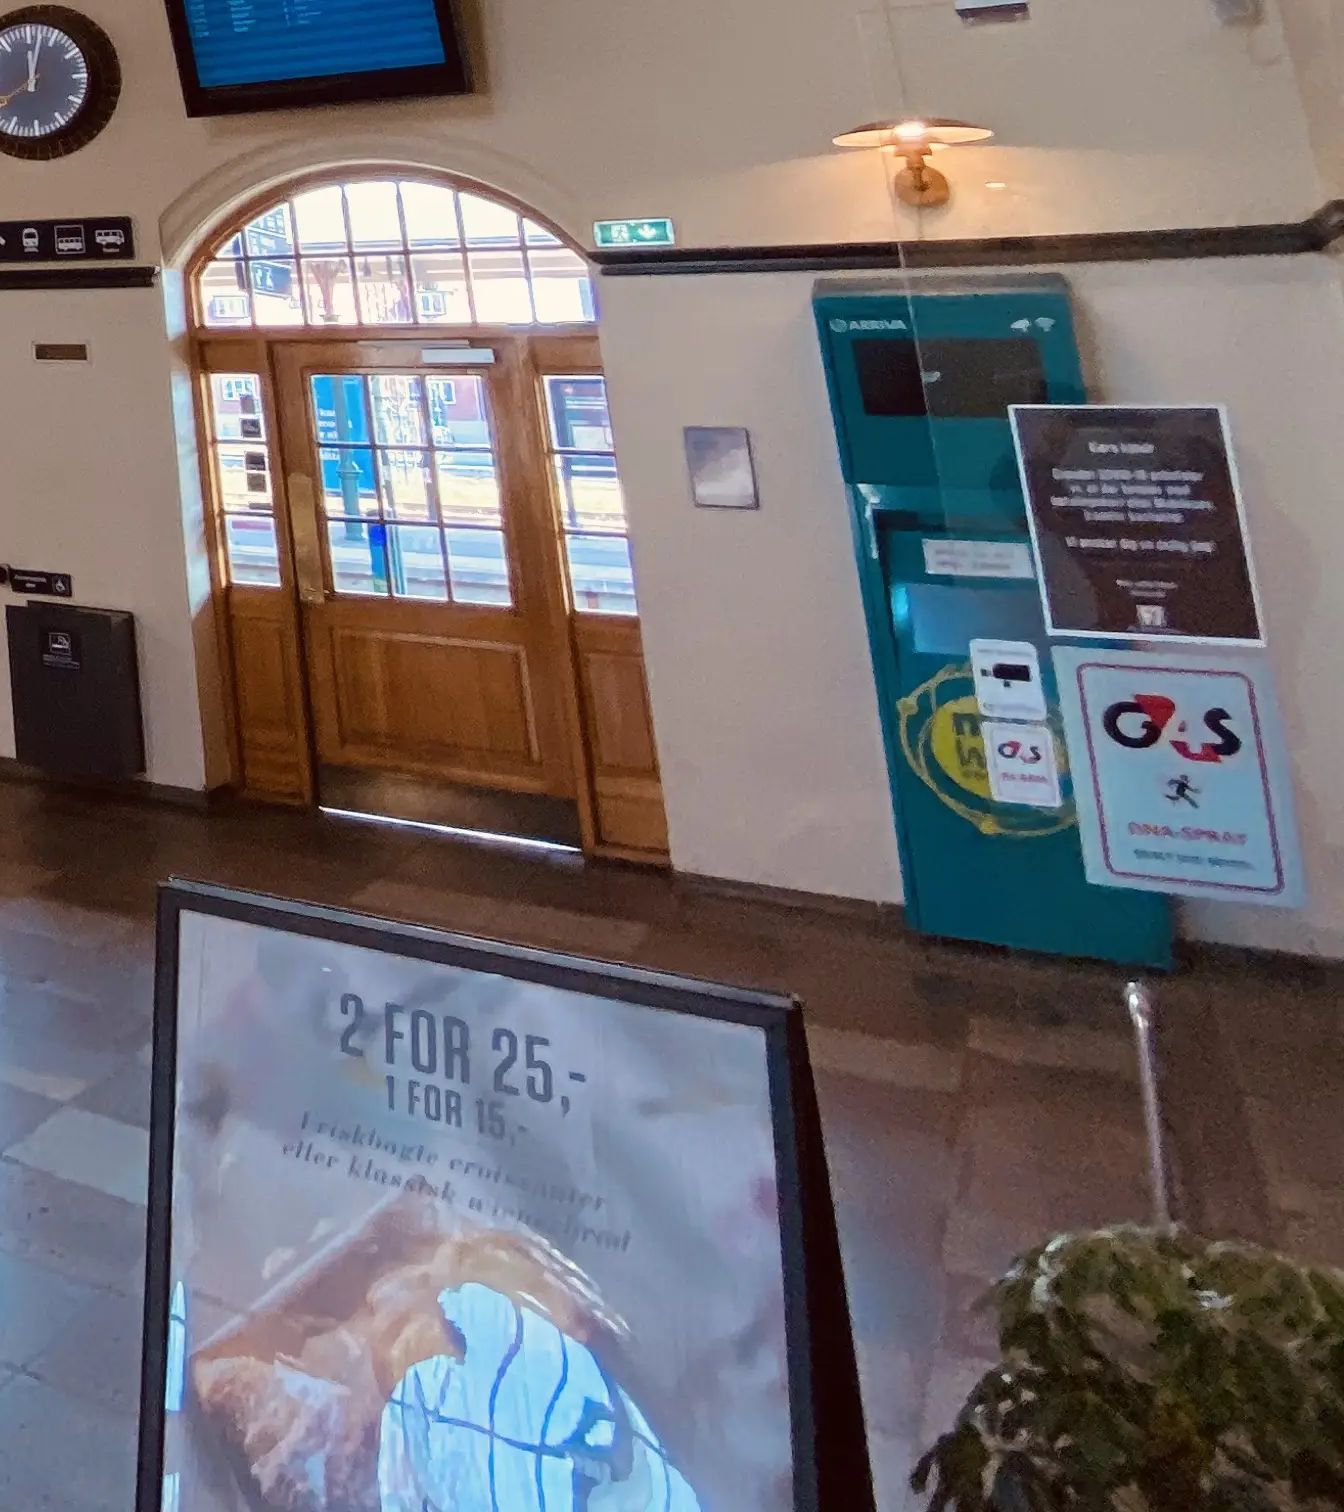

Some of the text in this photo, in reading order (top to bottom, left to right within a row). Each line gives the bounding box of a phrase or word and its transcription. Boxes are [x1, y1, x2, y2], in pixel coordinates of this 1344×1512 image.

[997, 741, 1041, 765] GS
[1103, 694, 1242, 763] G4S
[339, 993, 587, 1118] 2 FOR 25,-
[385, 1075, 395, 1112] 1
[408, 1080, 462, 1129] FOR
[282, 1140, 339, 1170] eller
